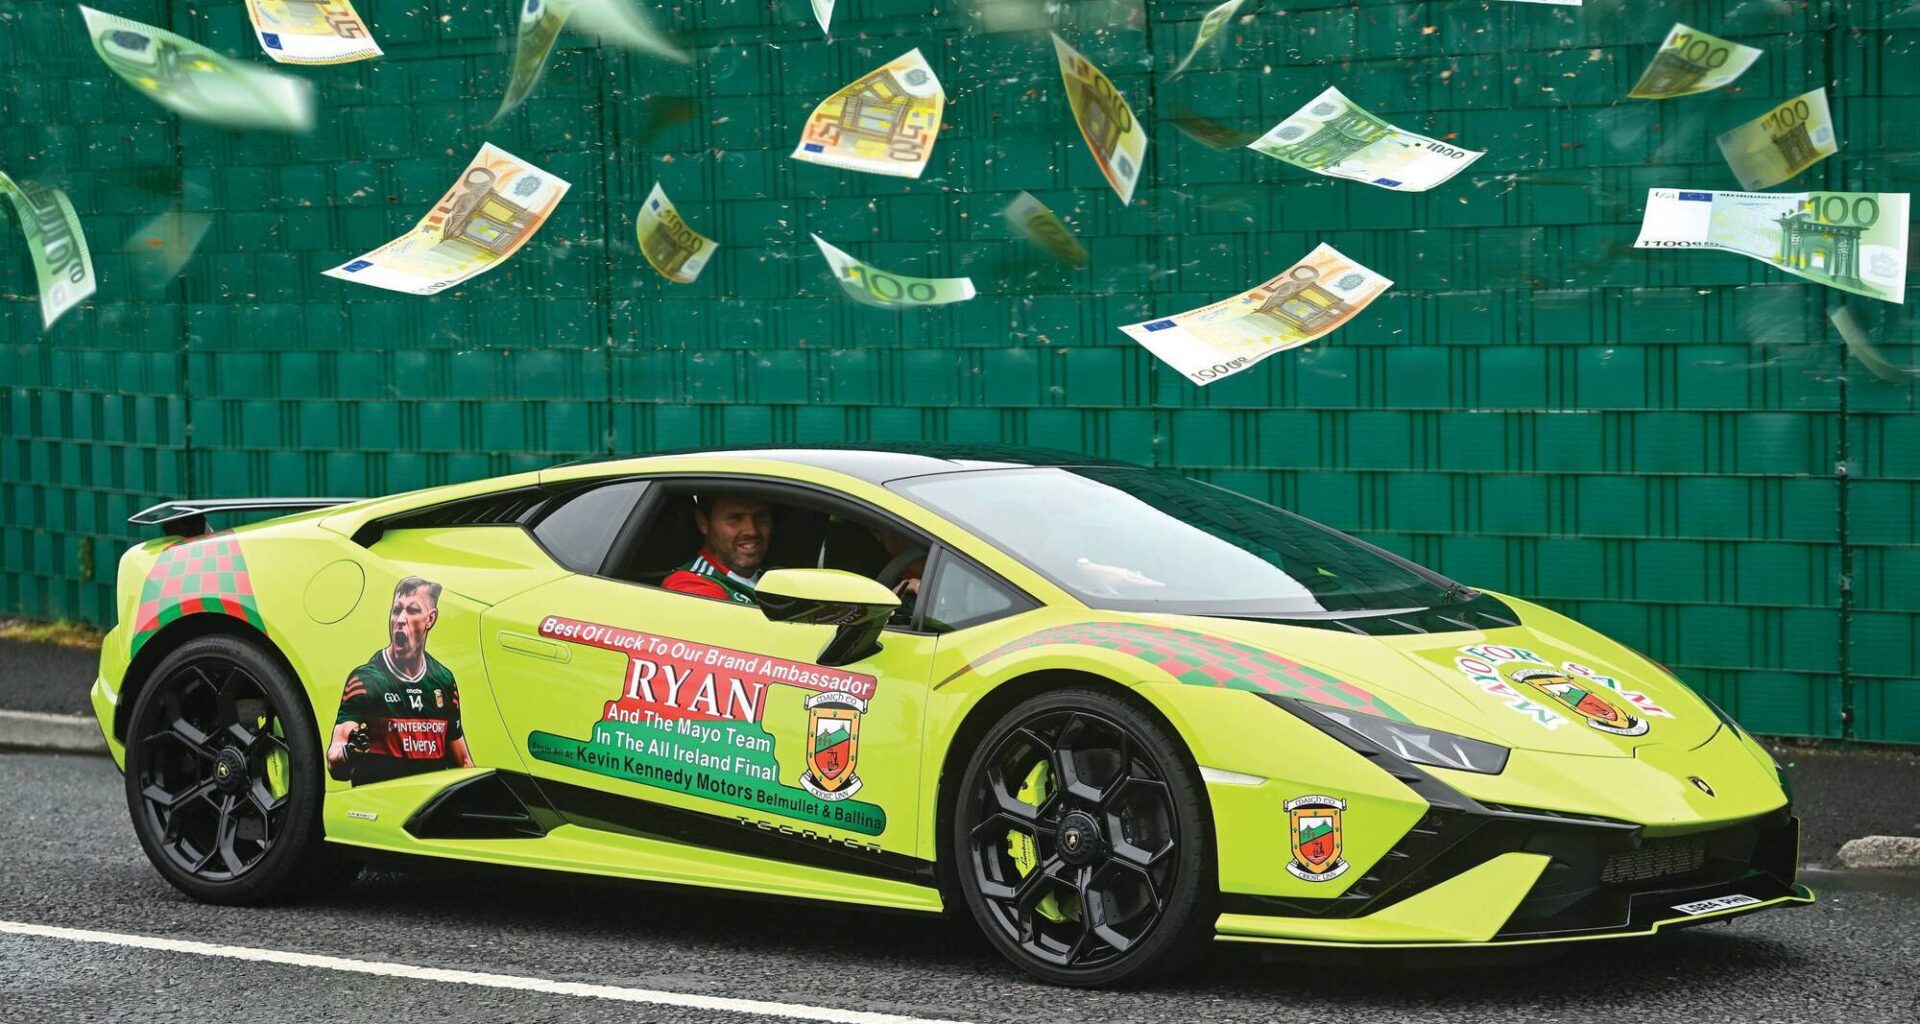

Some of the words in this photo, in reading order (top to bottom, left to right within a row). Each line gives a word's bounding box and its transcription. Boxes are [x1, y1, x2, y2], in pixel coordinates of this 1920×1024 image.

[1679, 33, 1729, 69] 100
[1770, 100, 1810, 132] 100
[1806, 195, 1880, 227] 100
[852, 266, 937, 302] 100
[542, 617, 582, 638] Best
[583, 626, 605, 641] Of
[603, 630, 646, 650] Luck
[647, 638, 668, 655] To
[671, 643, 704, 661] Our
[704, 649, 759, 673] Brand
[758, 660, 871, 696] Ambassador
[626, 658, 767, 724] RYAN
[398, 722, 446, 733] INTERSPORT
[402, 736, 437, 755] Elverys
[607, 703, 640, 724] And
[644, 710, 673, 731] The
[677, 717, 721, 744] Mayo
[726, 727, 770, 752] Team
[596, 727, 611, 746] In
[615, 731, 644, 752] The
[648, 738, 669, 758] All
[673, 743, 730, 771] Ireland
[734, 757, 777, 782] Final
[576, 746, 620, 770] Kevin
[624, 757, 692, 790] Kennedy
[696, 772, 753, 800] Motors
[756, 789, 819, 816] Belmullet
[822, 804, 831, 819] &
[834, 807, 881, 831] Ballina
